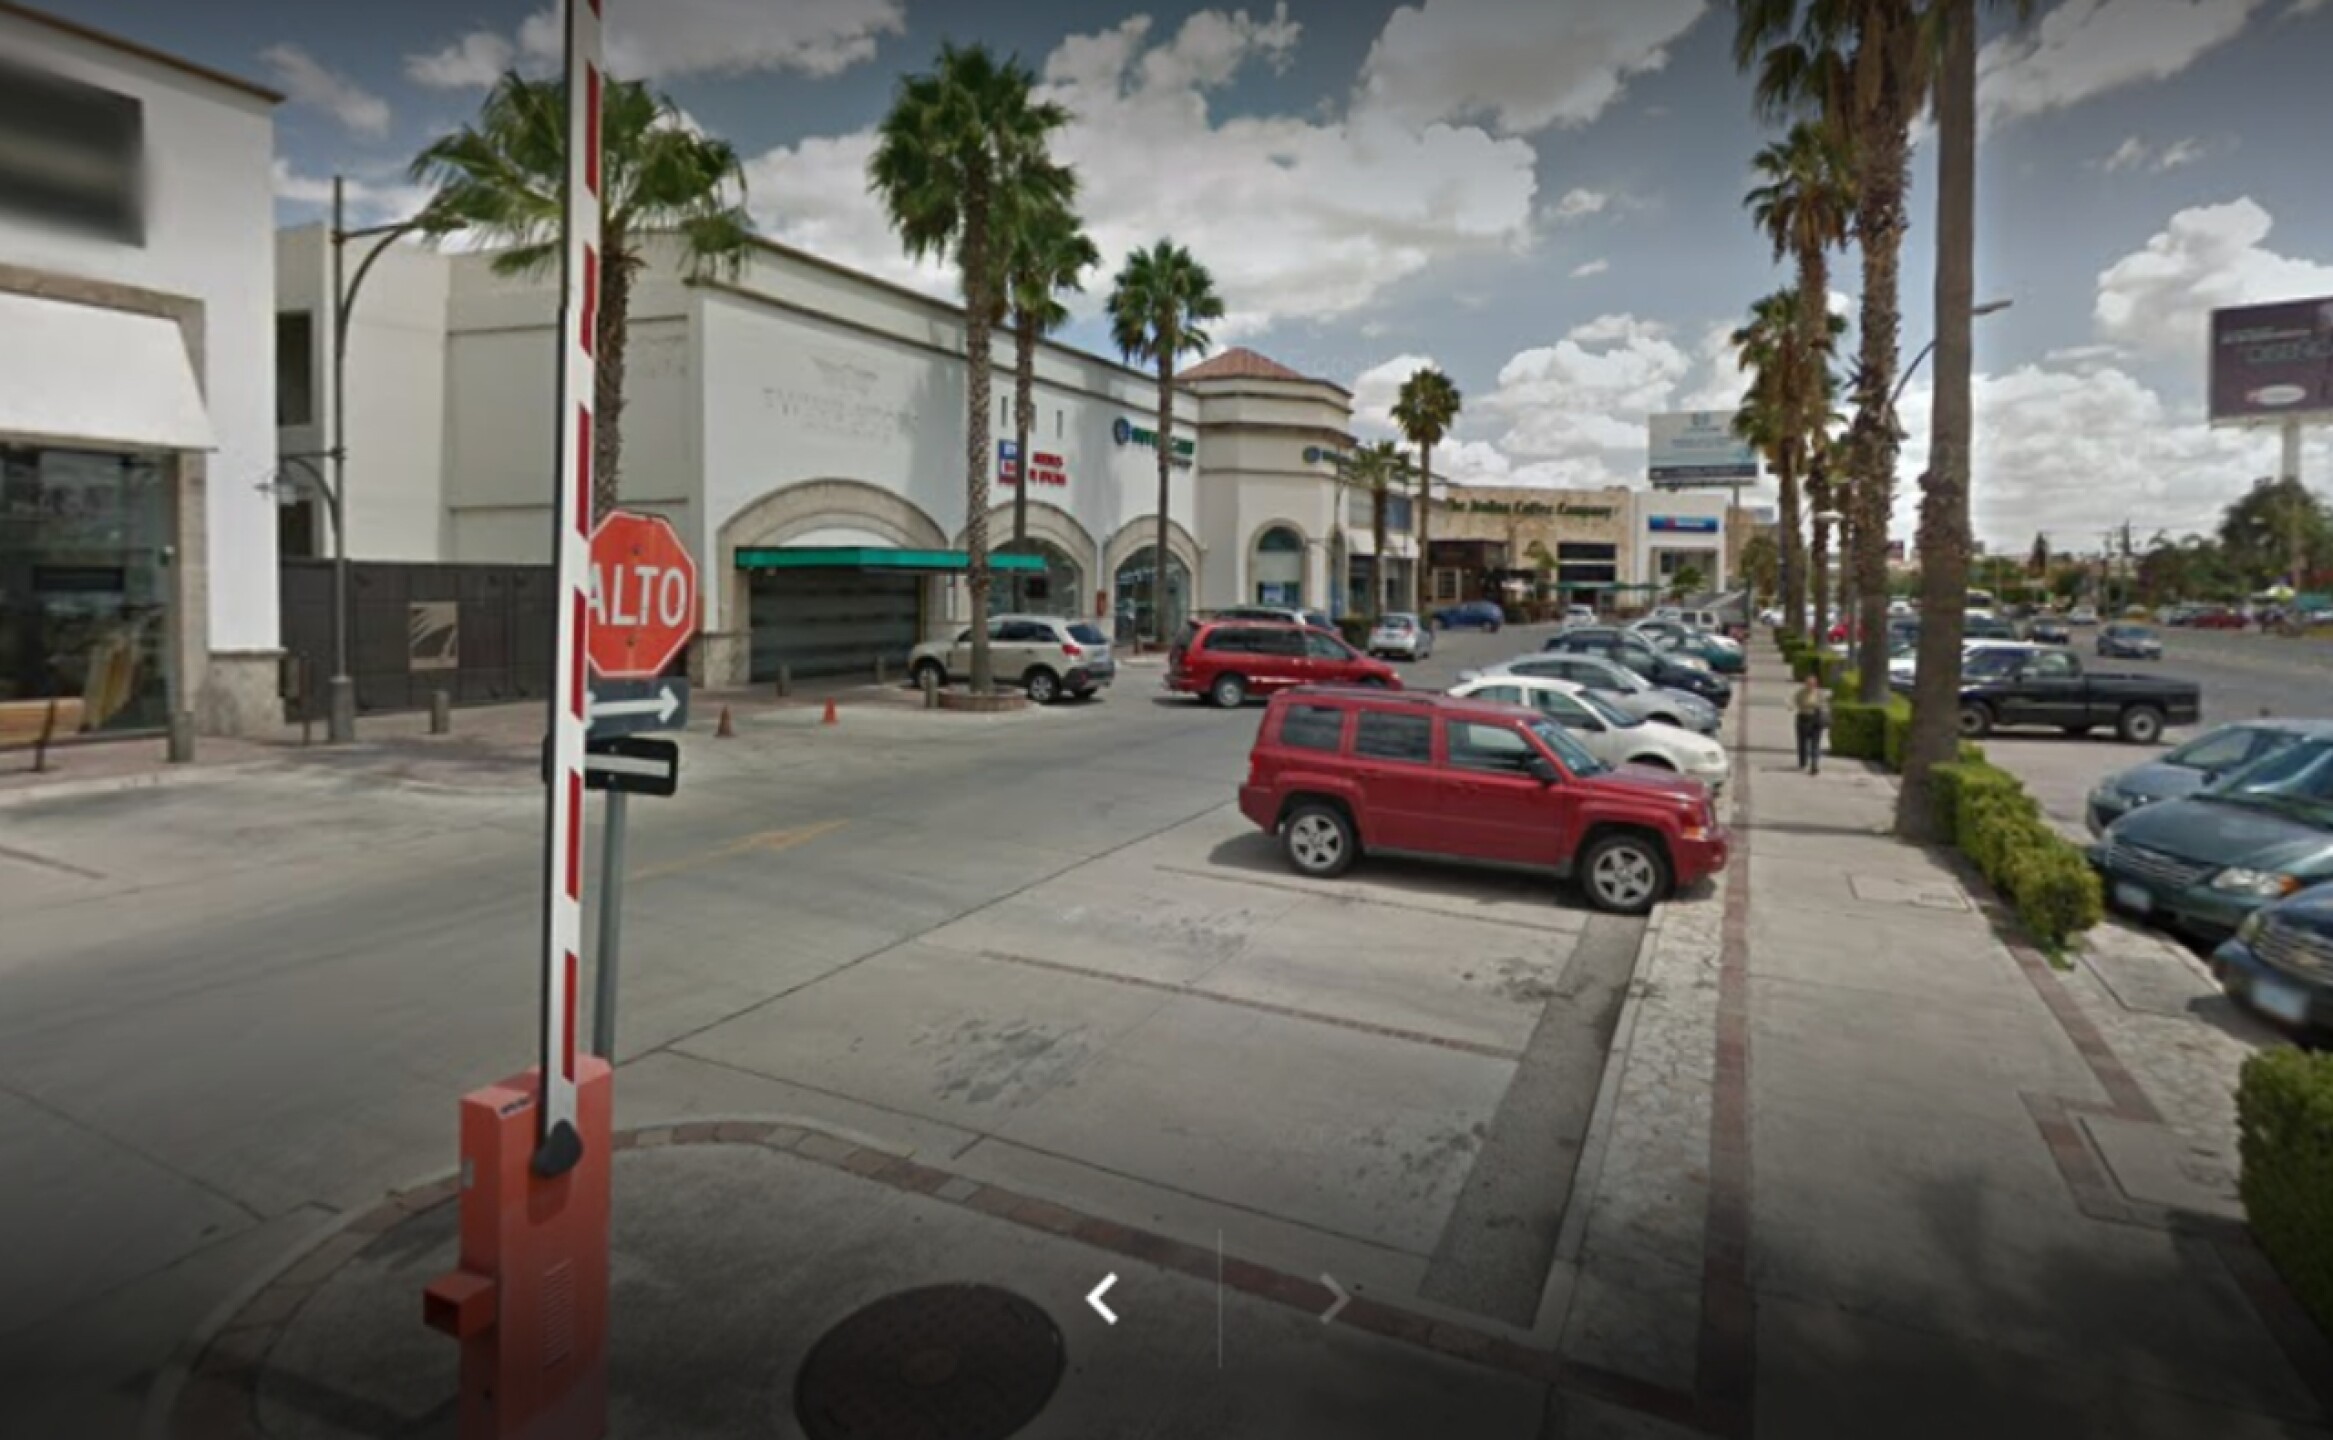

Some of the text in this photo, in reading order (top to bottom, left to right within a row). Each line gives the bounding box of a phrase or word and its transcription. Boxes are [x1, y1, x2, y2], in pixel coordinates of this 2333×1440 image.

[1513, 500, 1554, 515] Coffee
[1556, 501, 1613, 520] Company
[588, 562, 688, 629] ALTO
